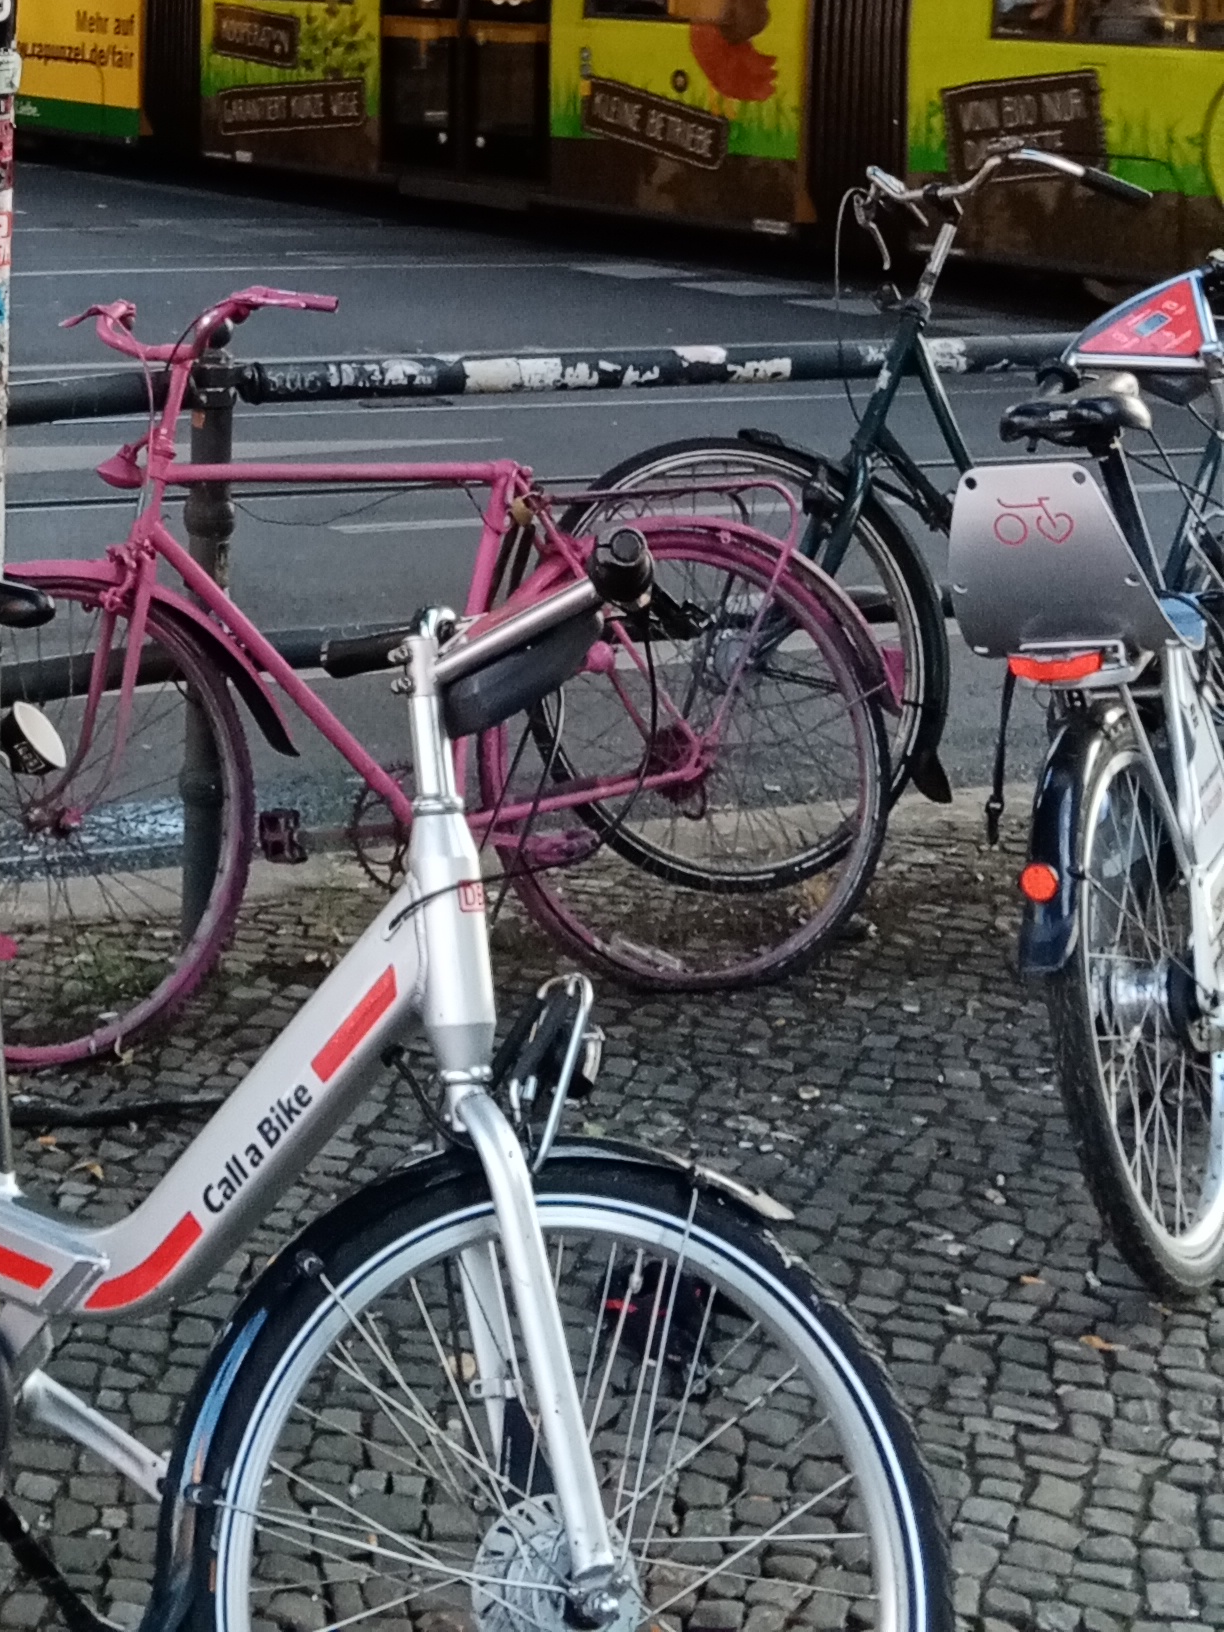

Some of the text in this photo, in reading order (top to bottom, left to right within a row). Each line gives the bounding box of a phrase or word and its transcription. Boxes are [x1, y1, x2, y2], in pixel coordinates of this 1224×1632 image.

[76, 9, 135, 37] Mehr auf
[202, 1082, 313, 1214] Call a Bike
